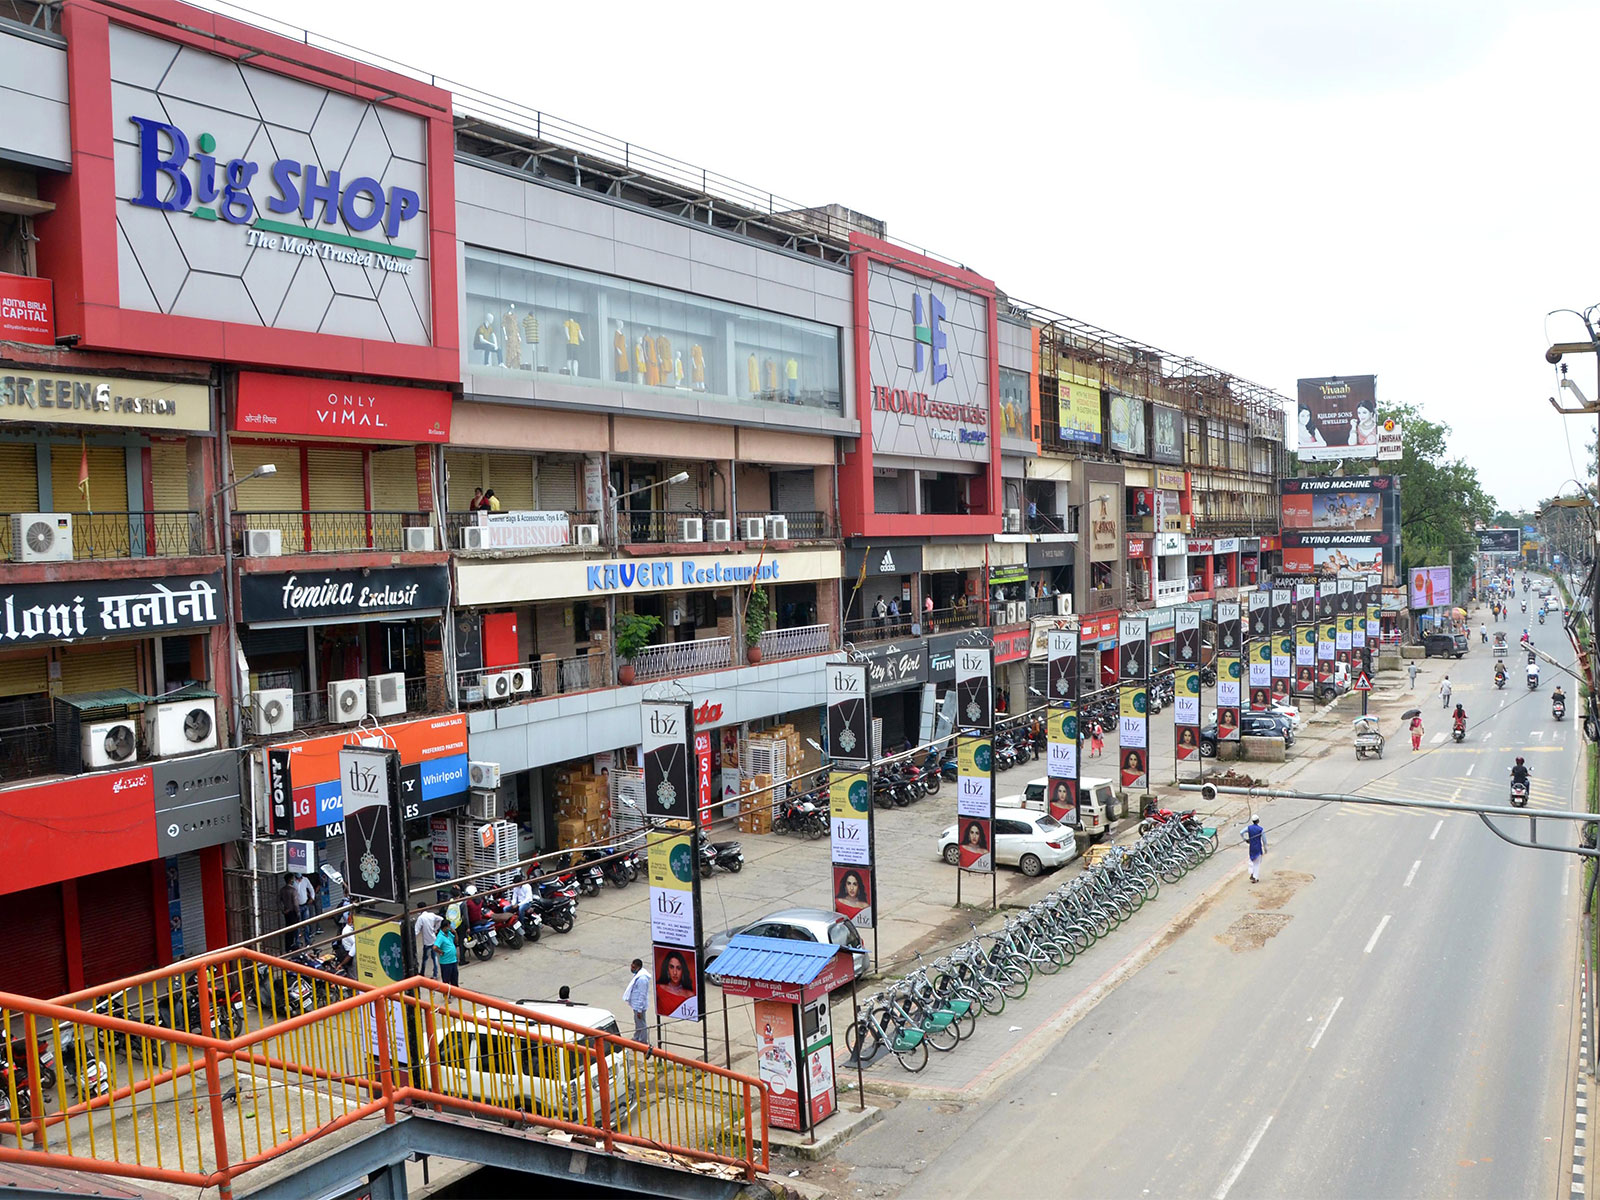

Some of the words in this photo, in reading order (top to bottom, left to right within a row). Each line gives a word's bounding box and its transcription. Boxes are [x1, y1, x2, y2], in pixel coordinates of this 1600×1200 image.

[129, 115, 259, 226] Big
[268, 158, 420, 238] SHOP
[246, 229, 278, 251] The
[280, 235, 318, 257] Most
[321, 243, 374, 267] Trusted
[375, 252, 414, 275] Name
[2, 297, 26, 309] ADITYA
[27, 300, 48, 312] BIRLA
[2, 306, 48, 323] CAPITAL
[114, 395, 177, 416] FASHION
[327, 393, 376, 408] ONLY
[874, 385, 928, 417] HOME
[928, 401, 987, 425] essentials
[316, 409, 386, 427] VIMAL
[1300, 480, 1330, 490] FLYING
[1331, 480, 1371, 489] MACHINE
[506, 515, 517, 524] Bags
[521, 513, 545, 522] Accessories,
[546, 513, 556, 523] Toys
[1301, 536, 1331, 544] FLYING
[587, 562, 674, 591] KAVERI
[682, 560, 780, 585] Restaurant
[880, 564, 896, 572] adidas
[282, 576, 354, 609] femina
[98, 581, 217, 630] सलोनी
[1221, 604, 1236, 617] tbz
[0, 594, 88, 640] loni
[1180, 612, 1196, 625] tbz
[1125, 622, 1142, 636] tbz
[1054, 635, 1072, 651] tbz
[899, 654, 920, 679] Girl
[962, 653, 983, 671] tbz
[834, 671, 858, 691] tbz
[1178, 699, 1194, 711] tbz
[450, 718, 462, 726] SALES
[650, 710, 678, 735] tbz
[1124, 717, 1141, 732] tbz
[422, 745, 446, 755] PREFERRED
[445, 741, 464, 751] PARTNER
[1052, 744, 1071, 761] tbz
[350, 761, 379, 794] tbz
[423, 768, 463, 786] Whirlpool
[272, 758, 285, 818] SONY
[700, 757, 710, 820] SALE
[963, 779, 983, 796] tbz
[293, 798, 310, 818] LG
[183, 815, 232, 832] CAPRESE
[838, 821, 860, 841] tbz
[297, 849, 306, 858] LG
[658, 891, 684, 916] tbz
[681, 1003, 697, 1018] tbz
